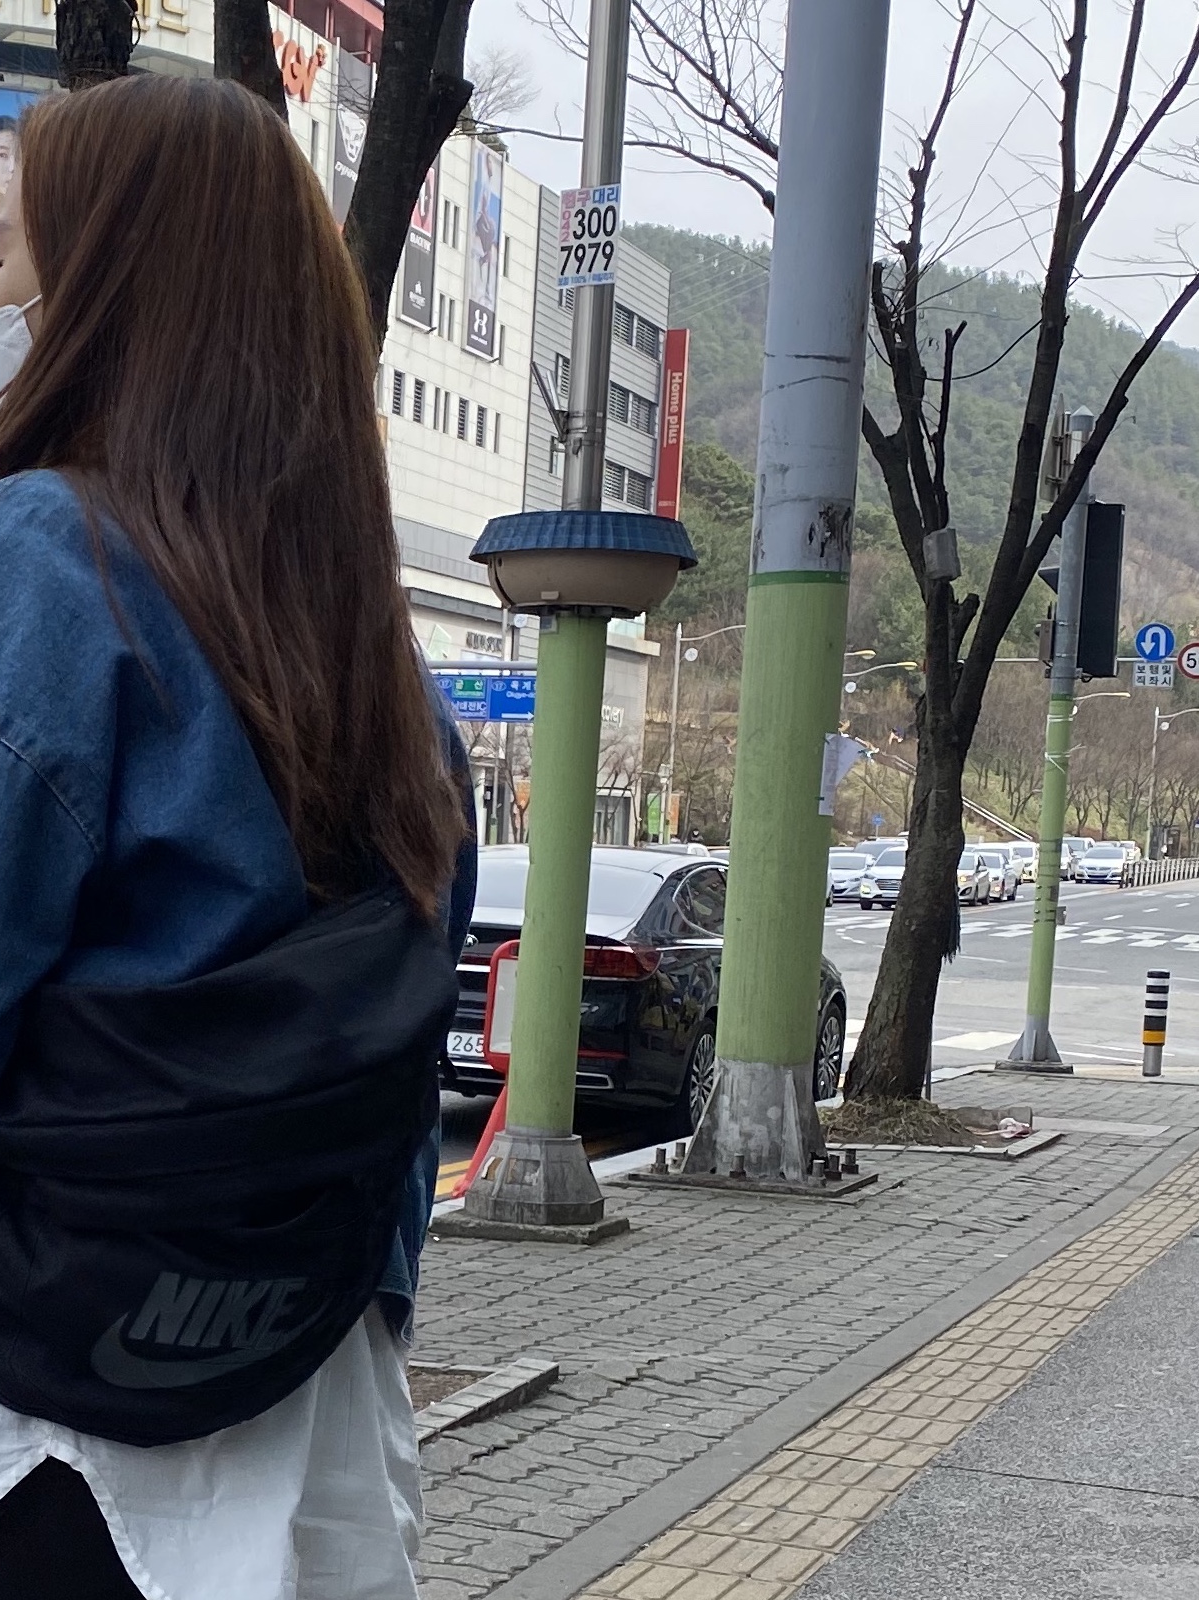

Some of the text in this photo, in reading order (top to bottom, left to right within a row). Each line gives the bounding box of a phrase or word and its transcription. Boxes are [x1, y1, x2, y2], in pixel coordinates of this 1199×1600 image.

[272, 30, 319, 103] GV
[572, 205, 617, 240] 300
[560, 240, 614, 276] 7979
[667, 371, 683, 445] Home plus
[510, 680, 536, 691] 옥계
[127, 1271, 309, 1351] NIKE
